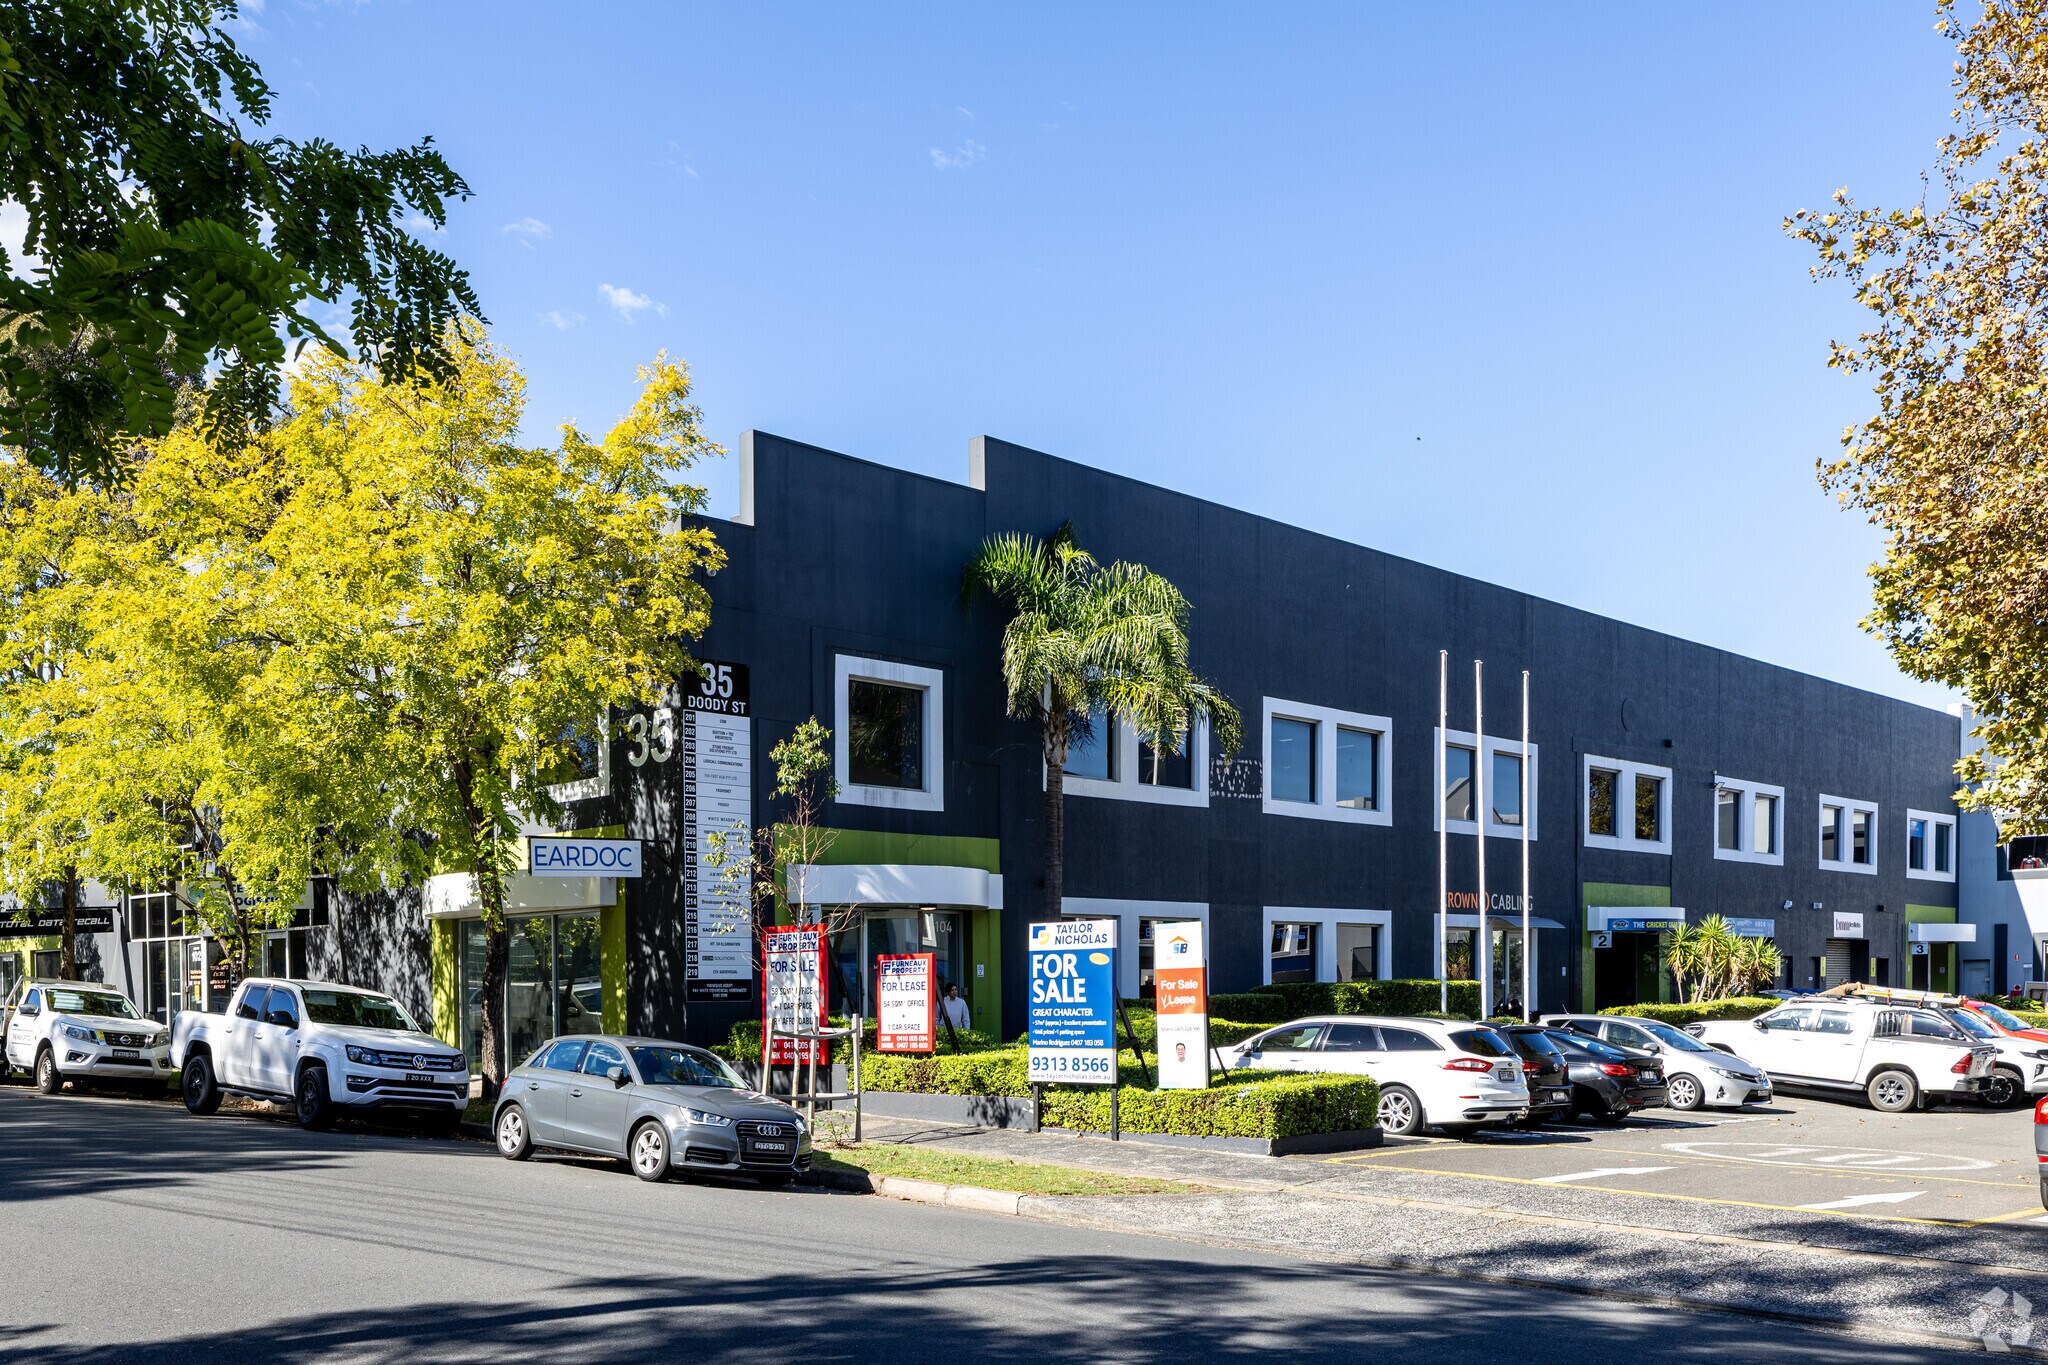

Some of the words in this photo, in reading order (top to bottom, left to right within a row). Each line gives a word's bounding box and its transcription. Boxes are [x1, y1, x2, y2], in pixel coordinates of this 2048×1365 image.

[701, 663, 733, 698] 35
[688, 695, 728, 712] DOODY
[732, 701, 746, 714] ST
[685, 714, 695, 722] 201
[685, 728, 695, 736] 202
[628, 708, 674, 767] 35
[685, 742, 695, 750] 203
[685, 756, 695, 764] 204
[685, 770, 695, 778] 205
[685, 785, 695, 793] 206
[685, 799, 695, 807] 207
[686, 813, 696, 821] 208
[534, 845, 632, 867] EARDOC
[686, 855, 696, 863] 211
[686, 869, 697, 877] 212
[686, 884, 697, 892] 213
[686, 898, 697, 906] 214
[1446, 892, 1478, 909] ROWN
[687, 912, 697, 920] 215
[687, 926, 697, 934] 216
[935, 920, 953, 933] 104
[1056, 923, 1093, 934] TAYLOR
[1054, 934, 1108, 945] NICHOLAS
[1599, 936, 1607, 946] 2
[1916, 945, 1924, 954] 3
[687, 954, 697, 962] 218
[771, 961, 788, 973] FOR
[1032, 954, 1078, 979] FOR
[882, 982, 897, 991] FOR
[900, 981, 927, 991] LEASE
[1160, 980, 1176, 990] For
[1178, 979, 1199, 989] Sale
[1032, 978, 1087, 1004] SALE
[1168, 995, 1196, 1005] Lease
[1032, 1008, 1052, 1017] GREAT
[1053, 1008, 1093, 1016] CHARACTER
[1032, 1056, 1067, 1071] 9313
[1072, 1057, 1109, 1072] 8566
